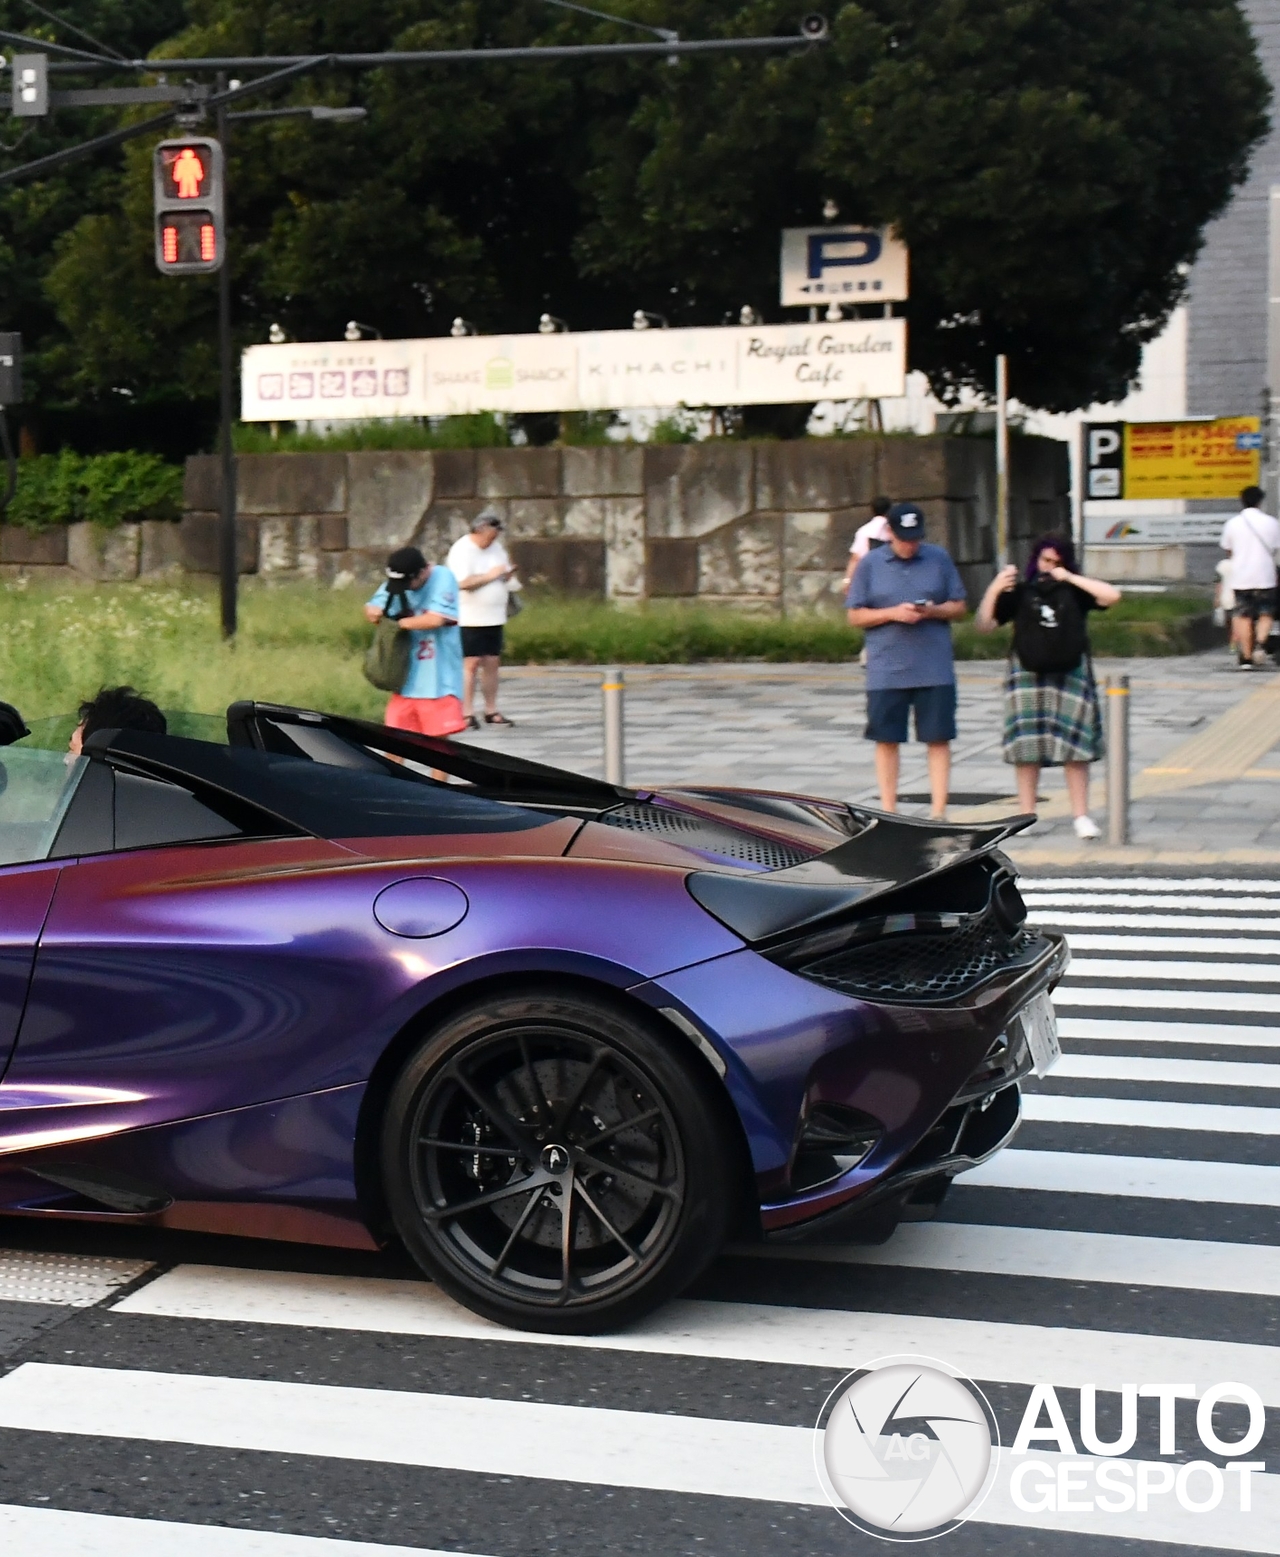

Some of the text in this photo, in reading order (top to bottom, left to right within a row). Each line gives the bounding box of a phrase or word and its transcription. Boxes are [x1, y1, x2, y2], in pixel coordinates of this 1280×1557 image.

[807, 233, 882, 279] P
[747, 333, 893, 363] Royal Garden
[432, 366, 569, 386] SHAKE SHACK
[587, 360, 726, 376] KIHACHI
[795, 362, 844, 388] Cafe
[1089, 428, 1120, 467] P
